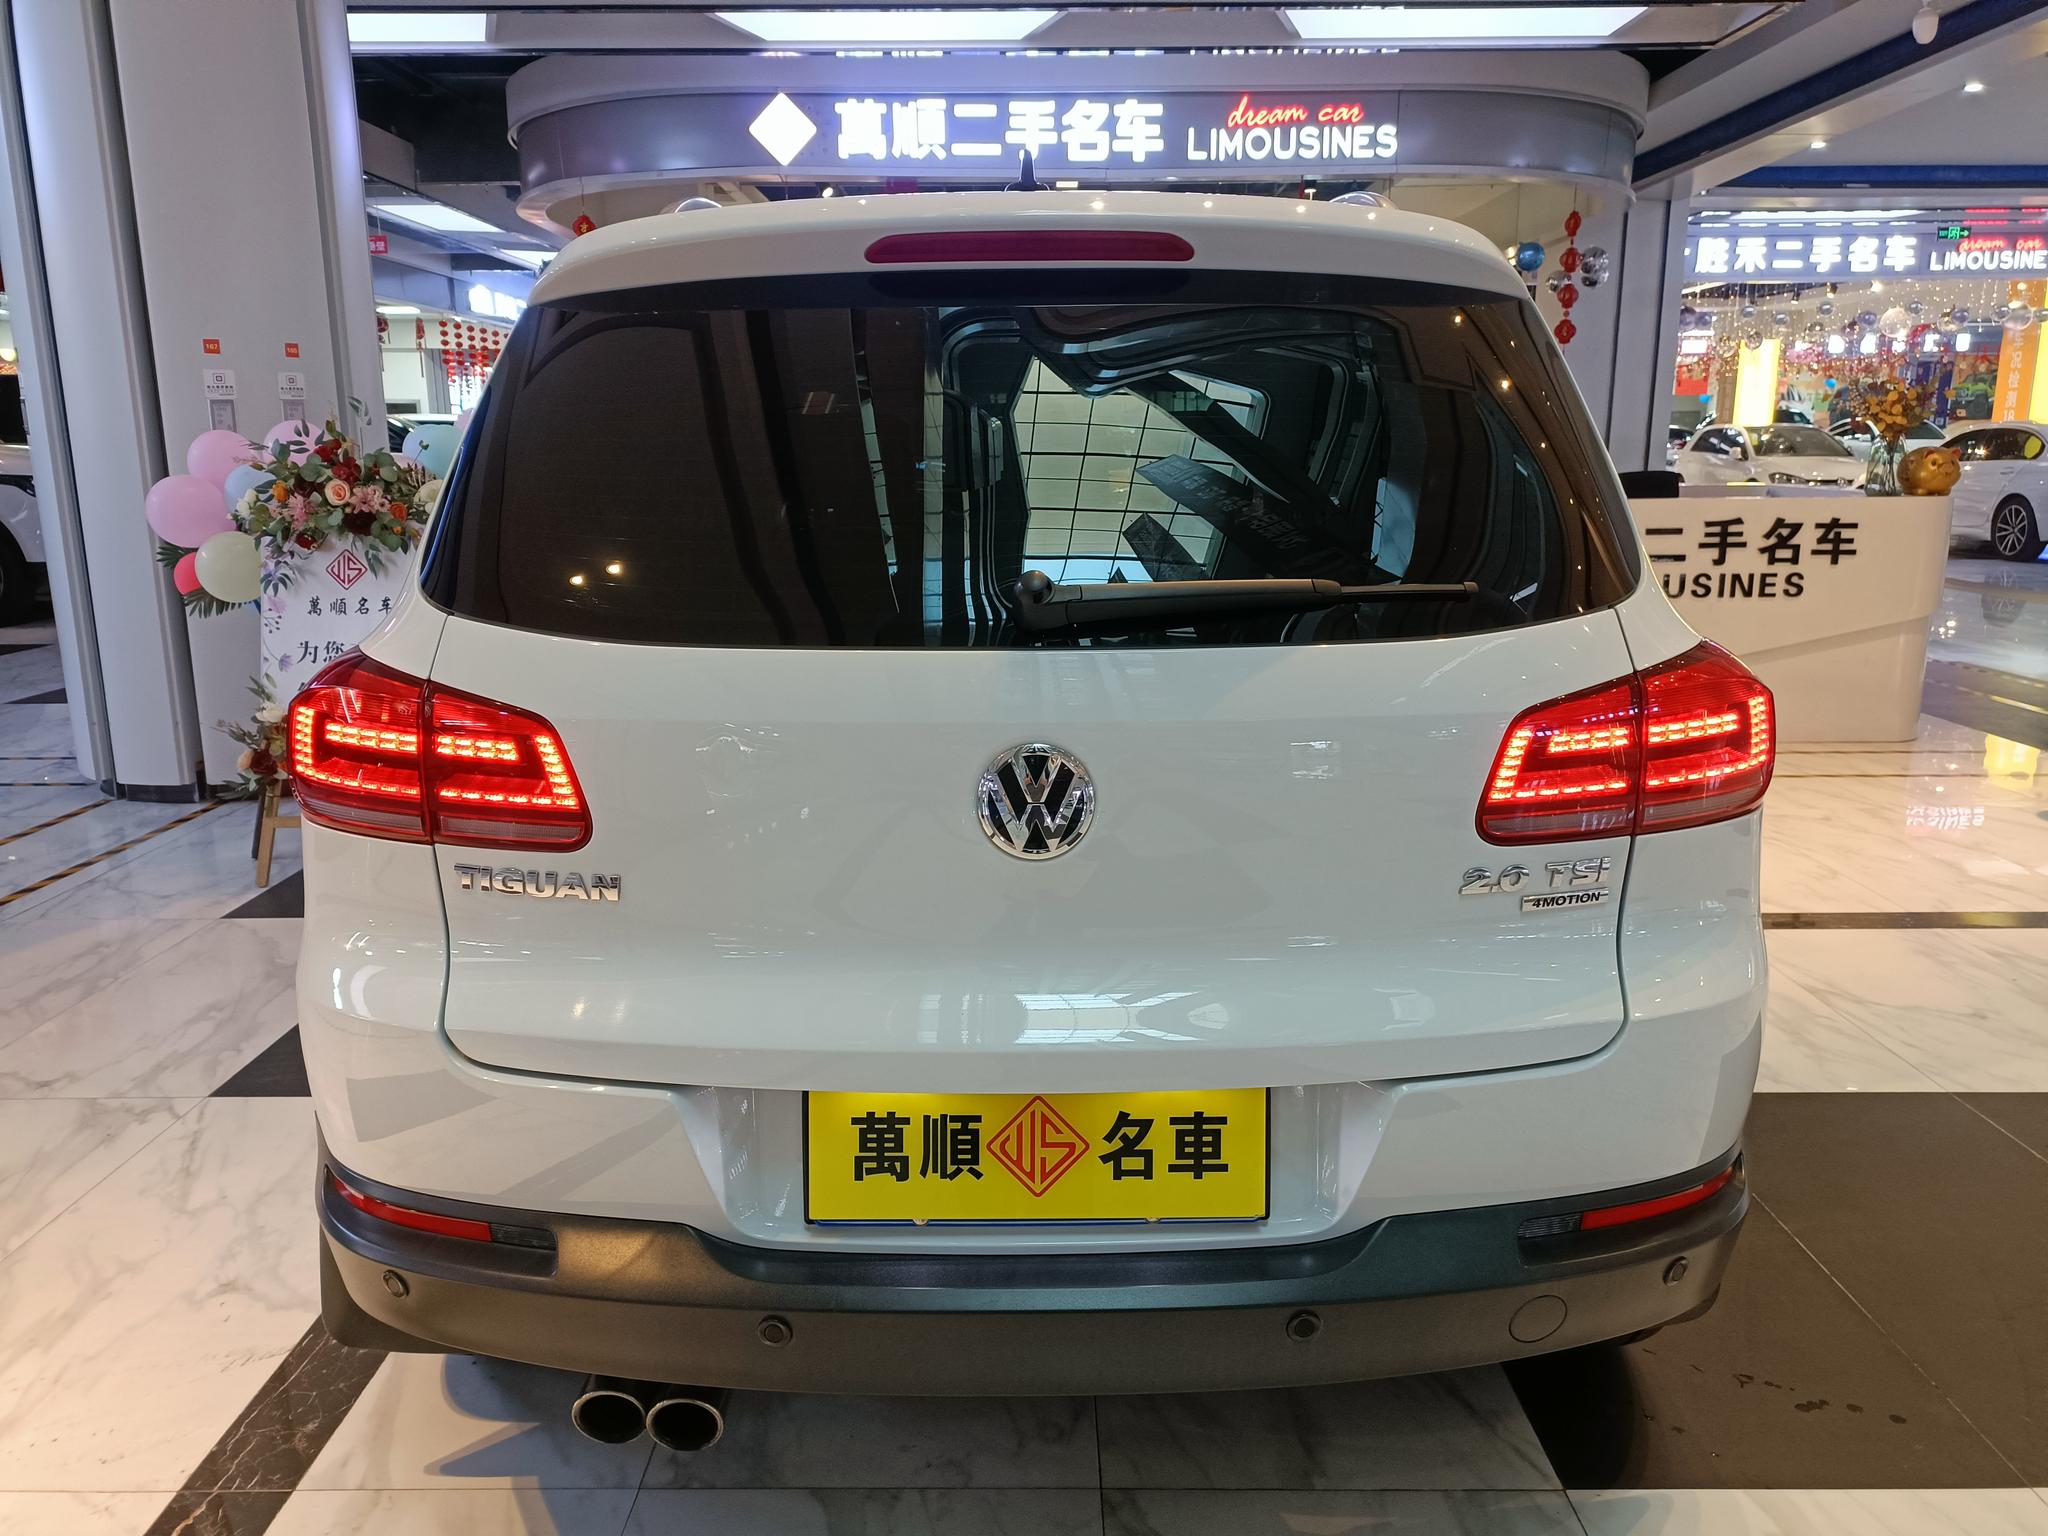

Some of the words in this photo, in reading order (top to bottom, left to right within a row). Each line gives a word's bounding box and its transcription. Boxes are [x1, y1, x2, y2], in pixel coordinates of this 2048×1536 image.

[1228, 95, 1309, 128] dream
[1317, 104, 1364, 123] car
[1187, 124, 1398, 162] LIMOUSINES
[1929, 250, 2048, 270] LIMOUSINE
[1645, 517, 1859, 566] 二手名车
[454, 863, 621, 901] TIGUAN
[1459, 864, 1531, 895] 2.0
[1545, 856, 1612, 888] TSI
[1532, 892, 1601, 909] 4MOTION
[851, 1111, 984, 1183] 萬順
[1098, 1111, 1229, 1181] 名車
